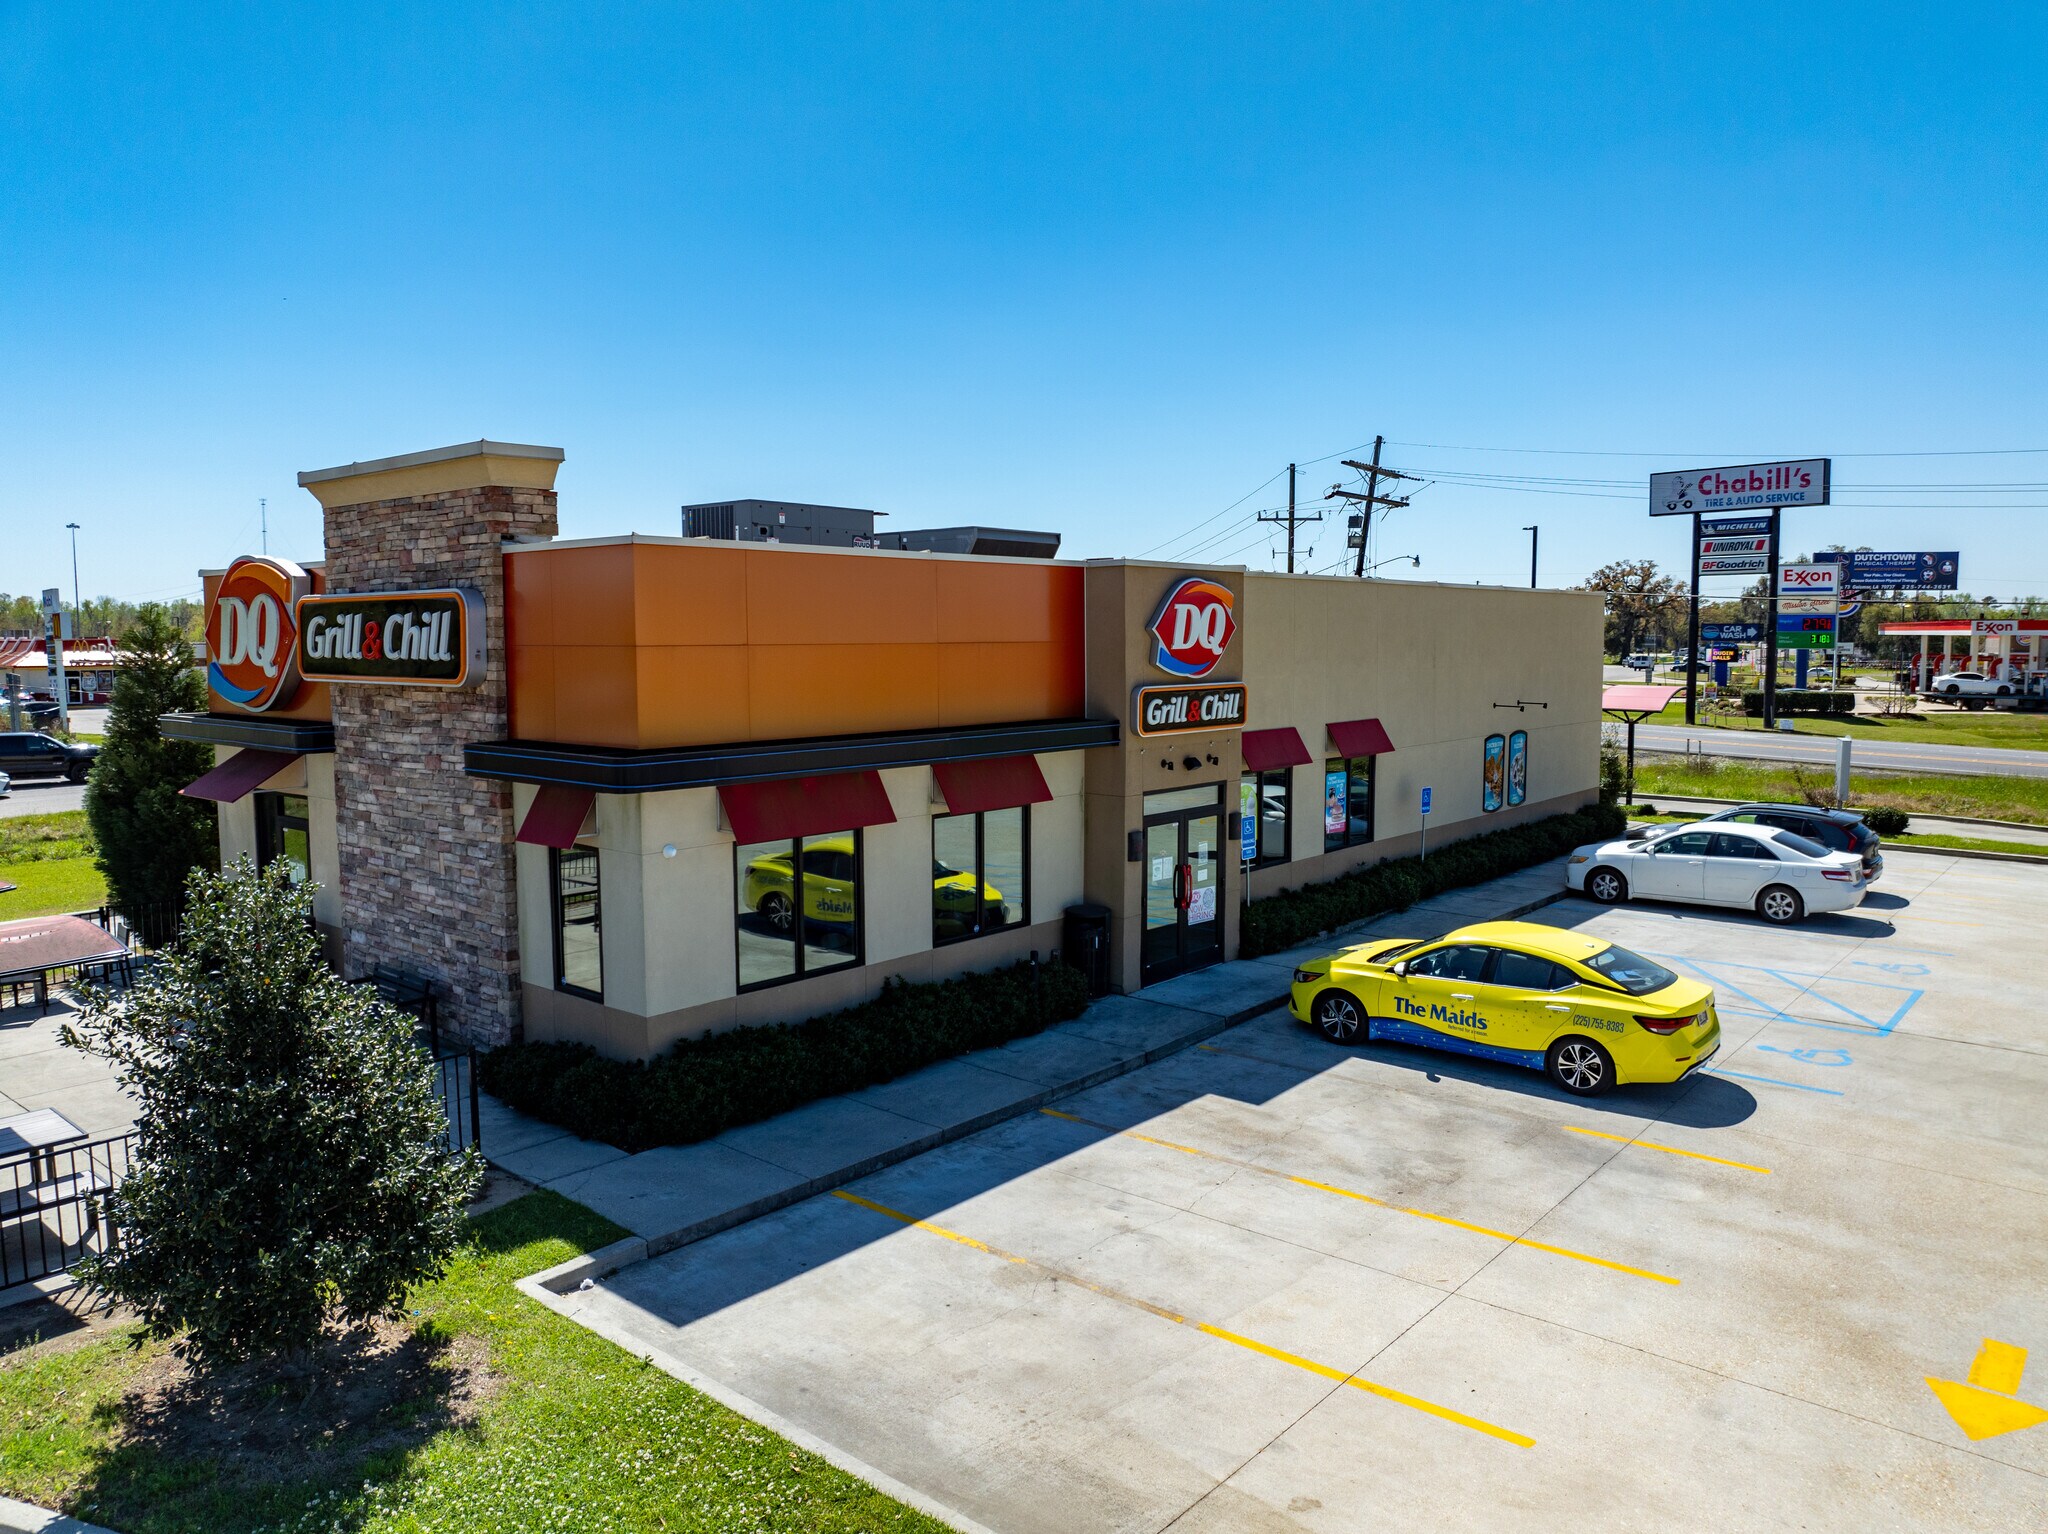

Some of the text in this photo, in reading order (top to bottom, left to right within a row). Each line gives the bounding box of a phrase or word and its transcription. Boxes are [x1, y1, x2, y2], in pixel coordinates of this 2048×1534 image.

[1698, 467, 1811, 495] Chabill's
[1705, 492, 1805, 507] TIRE & AUTO SERVICE
[1716, 522, 1767, 531] MICHELIN
[1712, 541, 1755, 552] UNIROYAL
[1702, 560, 1765, 570] BFGoodrich
[1783, 569, 1832, 586] Exxon
[218, 593, 279, 678] DQ
[306, 610, 451, 662] Grill & Chill
[1171, 603, 1226, 655] DQ
[1976, 622, 2013, 634] Exxon
[1147, 693, 1240, 725] Grill & Chill
[1189, 909, 1214, 920] HIRING
[1394, 996, 1487, 1030] The Maids
[1573, 1014, 1624, 1033] (225) 755-8383
